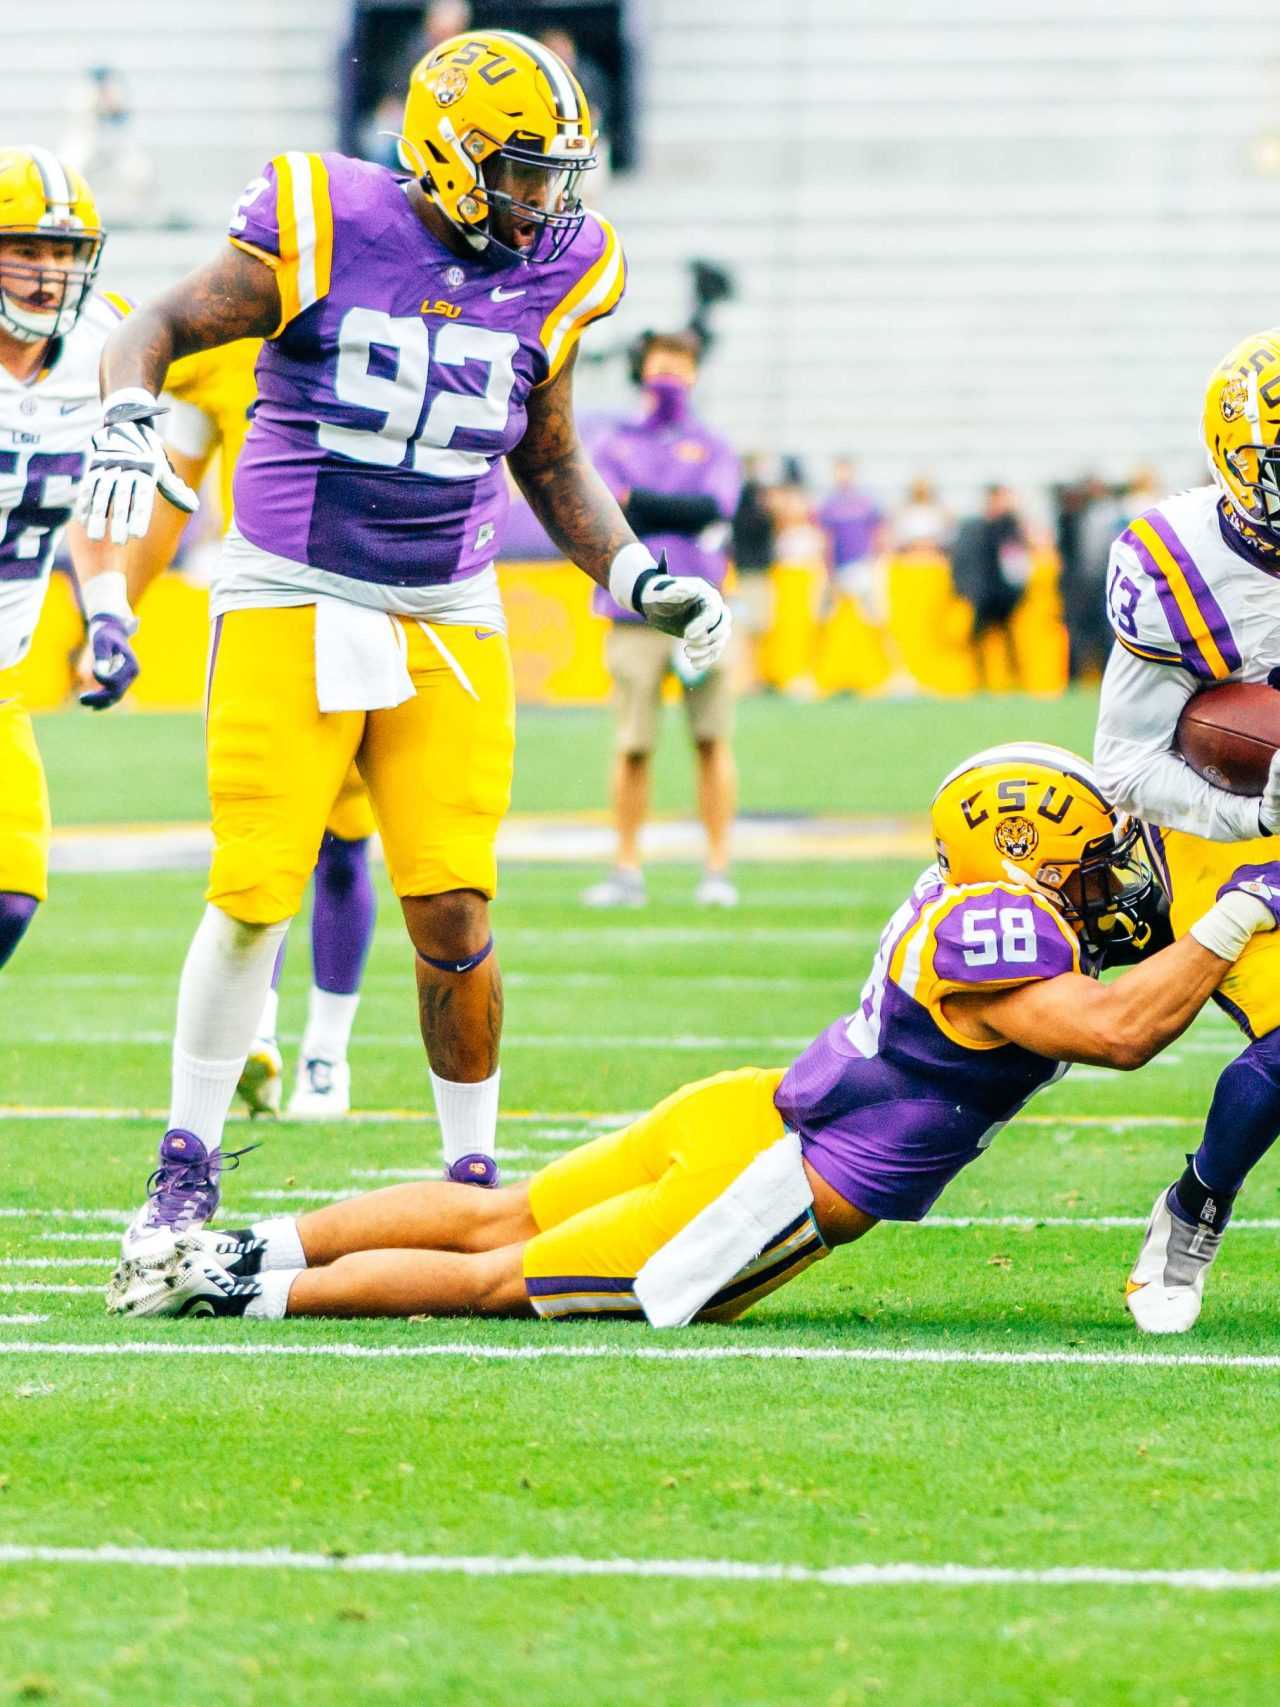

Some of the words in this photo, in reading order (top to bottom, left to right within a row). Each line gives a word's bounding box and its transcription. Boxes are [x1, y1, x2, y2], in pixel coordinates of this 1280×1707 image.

[420, 299, 462, 319] LSU
[316, 306, 520, 478] 92
[1108, 564, 1142, 639] 13
[960, 779, 1075, 830] LSU
[961, 908, 1038, 967] 58
